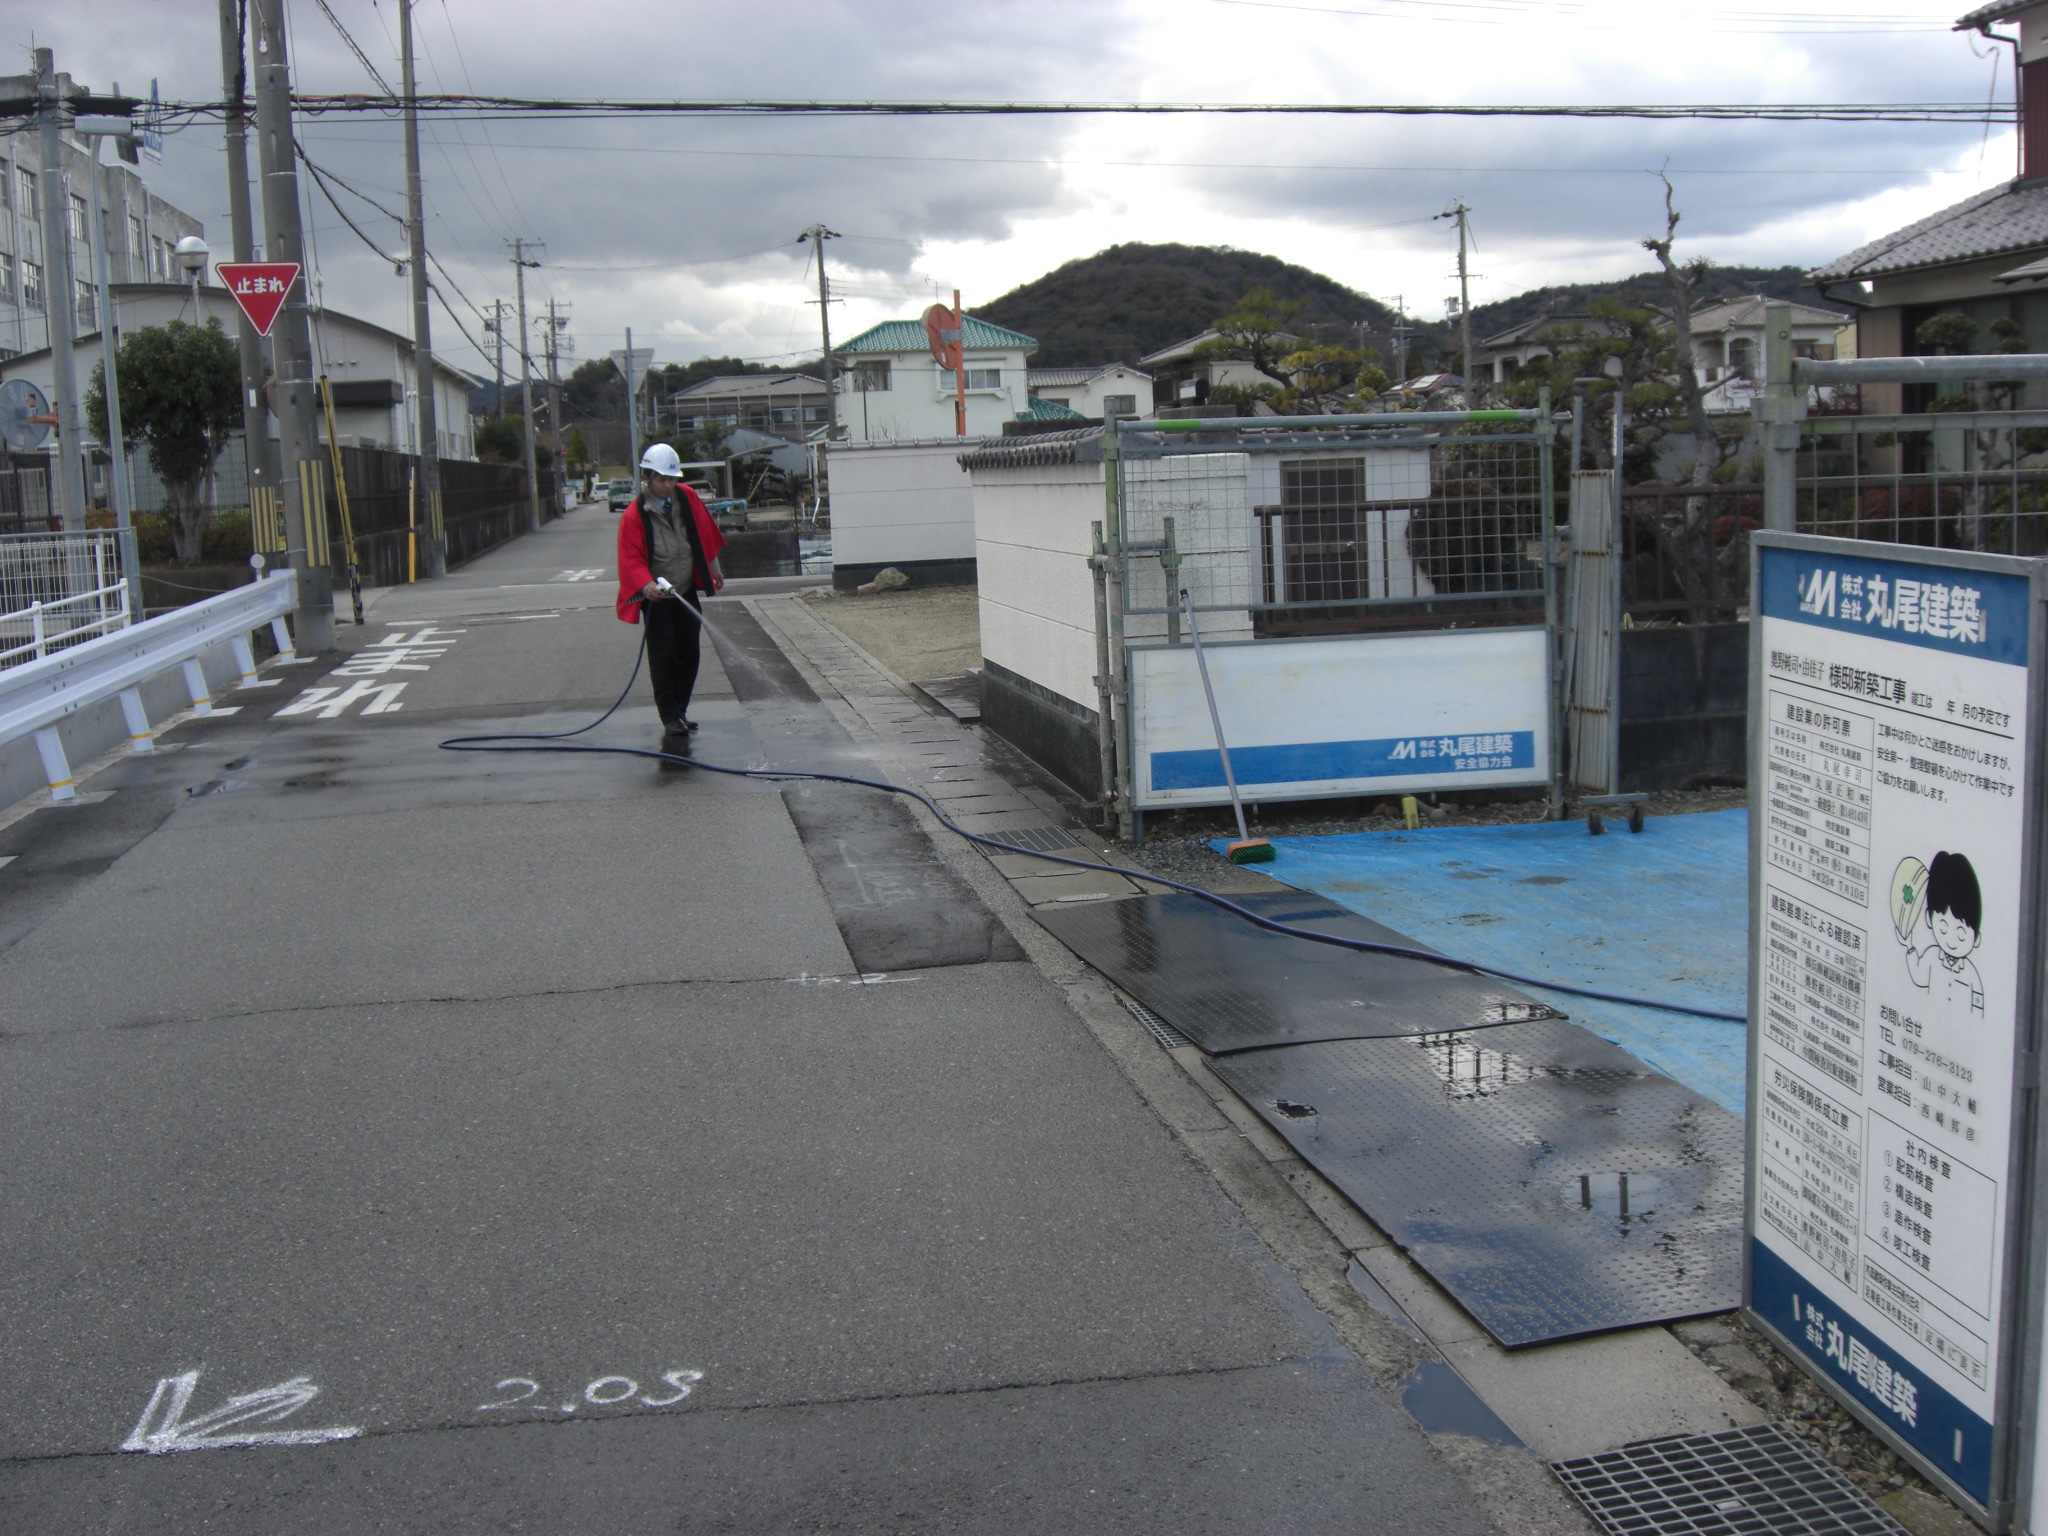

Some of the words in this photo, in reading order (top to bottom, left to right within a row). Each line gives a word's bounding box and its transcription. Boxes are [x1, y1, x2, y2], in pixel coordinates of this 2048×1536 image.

[236, 276, 285, 294] 止まれ
[1866, 574, 1980, 643] 丸尾建築
[273, 627, 467, 718] 止まれ
[1829, 663, 1907, 704] 様邸新築工事
[1947, 700, 1956, 714] 年
[1962, 703, 2011, 728] 月の予定です
[1787, 703, 1851, 738] 建設業の許可票
[1439, 734, 1513, 757] 丸尾建築
[1455, 755, 1512, 770] 安全協力会
[1771, 892, 1860, 953] 建築基準法による確認済
[1880, 1005, 1922, 1038] お問い合せ
[1879, 1025, 1896, 1046] TEL
[1902, 1038, 1973, 1082] 079-276-3123
[1774, 1068, 1849, 1132] 労災保険関係成立票
[1896, 1156, 1934, 1193] 配筋検査
[1906, 1140, 1951, 1179] 社内検査
[1895, 1182, 1933, 1219] 構造検査
[1894, 1208, 1932, 1245] 造作検査
[1893, 1234, 1931, 1271] 竣工検査
[1827, 1320, 1918, 1428] 丸尾建築
